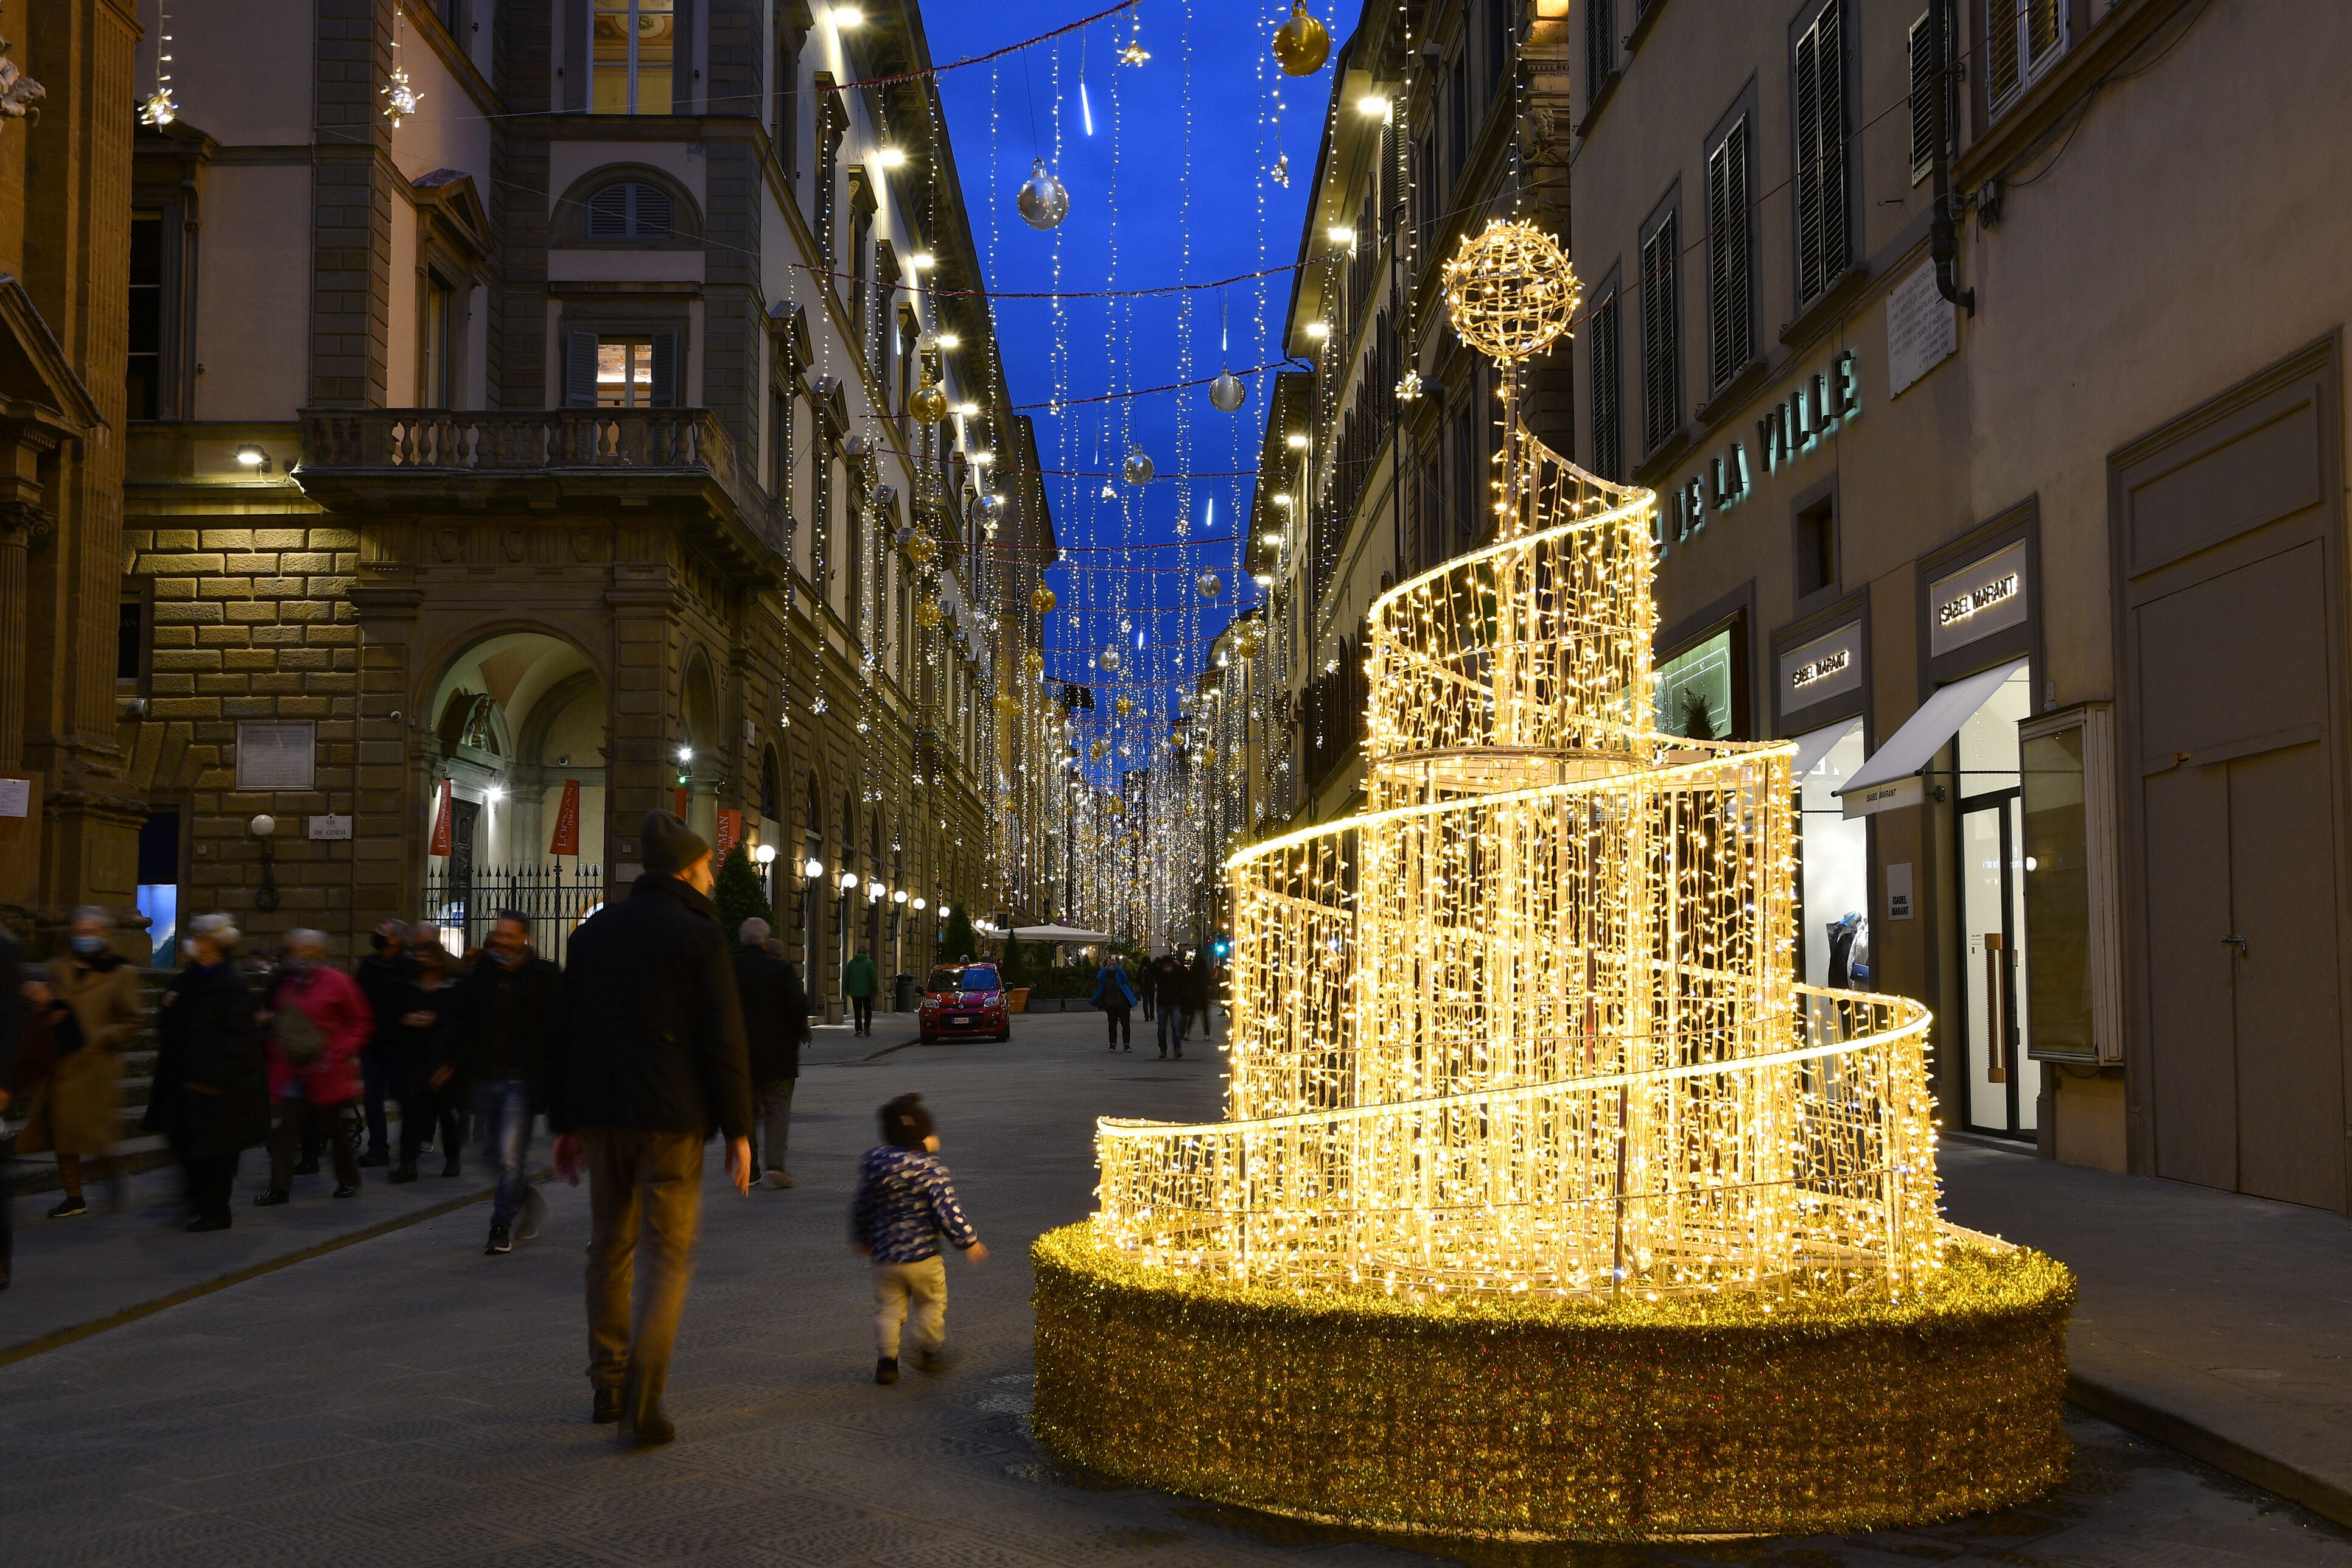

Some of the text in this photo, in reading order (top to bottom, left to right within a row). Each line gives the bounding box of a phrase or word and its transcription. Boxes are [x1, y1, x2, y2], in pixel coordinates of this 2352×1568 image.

[1672, 477, 1699, 541] DE
[1710, 444, 1743, 509] LA
[1756, 350, 1855, 472] VILLE
[1939, 575, 2014, 625] ISABEL MARANT
[1792, 651, 1846, 687] ISABEL MARANT
[1866, 788, 1897, 803] ISABEL MARANT
[579, 863, 604, 877] LO
[1892, 895, 1908, 905] ISABEL
[1891, 906, 1909, 916] MARANT
